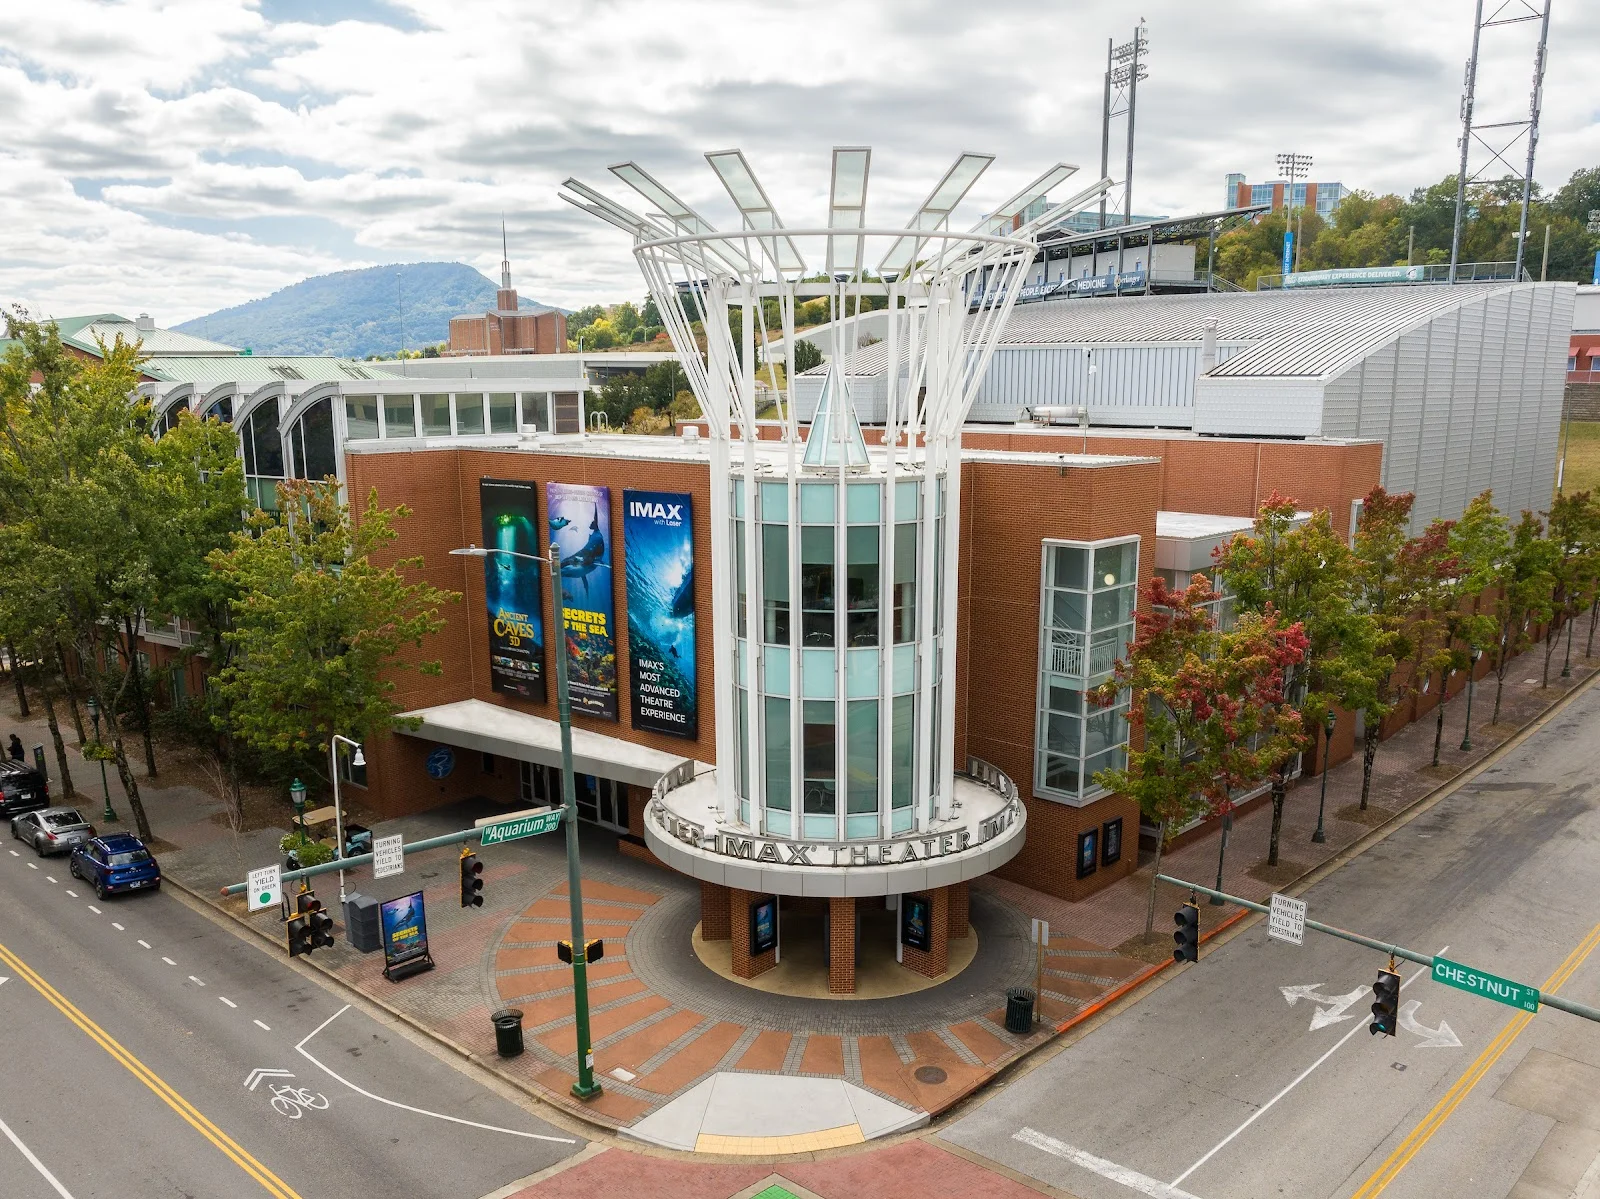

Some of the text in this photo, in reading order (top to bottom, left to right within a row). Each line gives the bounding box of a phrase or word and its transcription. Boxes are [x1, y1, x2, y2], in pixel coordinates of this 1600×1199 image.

[1332, 272, 1365, 280] EXPERIENCE
[1367, 270, 1402, 279] DELIVERED.
[562, 607, 607, 625] ECRETS
[571, 621, 587, 632] THE
[589, 624, 609, 637] SEA
[509, 636, 520, 647] 3D
[639, 658, 664, 671] IMAX'S
[639, 671, 661, 682] MOST
[640, 683, 680, 698] ADVANCED
[640, 695, 673, 709] THEATRE
[640, 707, 686, 724] EXPERIENCE
[485, 812, 560, 841] W Aquarium WAY
[544, 822, 556, 832] 200
[375, 837, 401, 849] TURNING
[828, 831, 971, 867] THEATER
[375, 845, 402, 857] VEHICLES
[376, 854, 402, 866] YIELD TO
[375, 862, 404, 874] PEDESTRIANS
[253, 871, 263, 879] LEFT
[255, 875, 275, 886] YIELD
[262, 882, 277, 892] GREEN
[1274, 896, 1304, 912] TURNING
[1272, 906, 1304, 922] VEHICLES
[1272, 915, 1302, 931] YIELD TO
[1269, 924, 1304, 941] PEDESTRIANS
[1435, 963, 1535, 1001] CHESTNUT ST
[1523, 1001, 1536, 1011] 100
